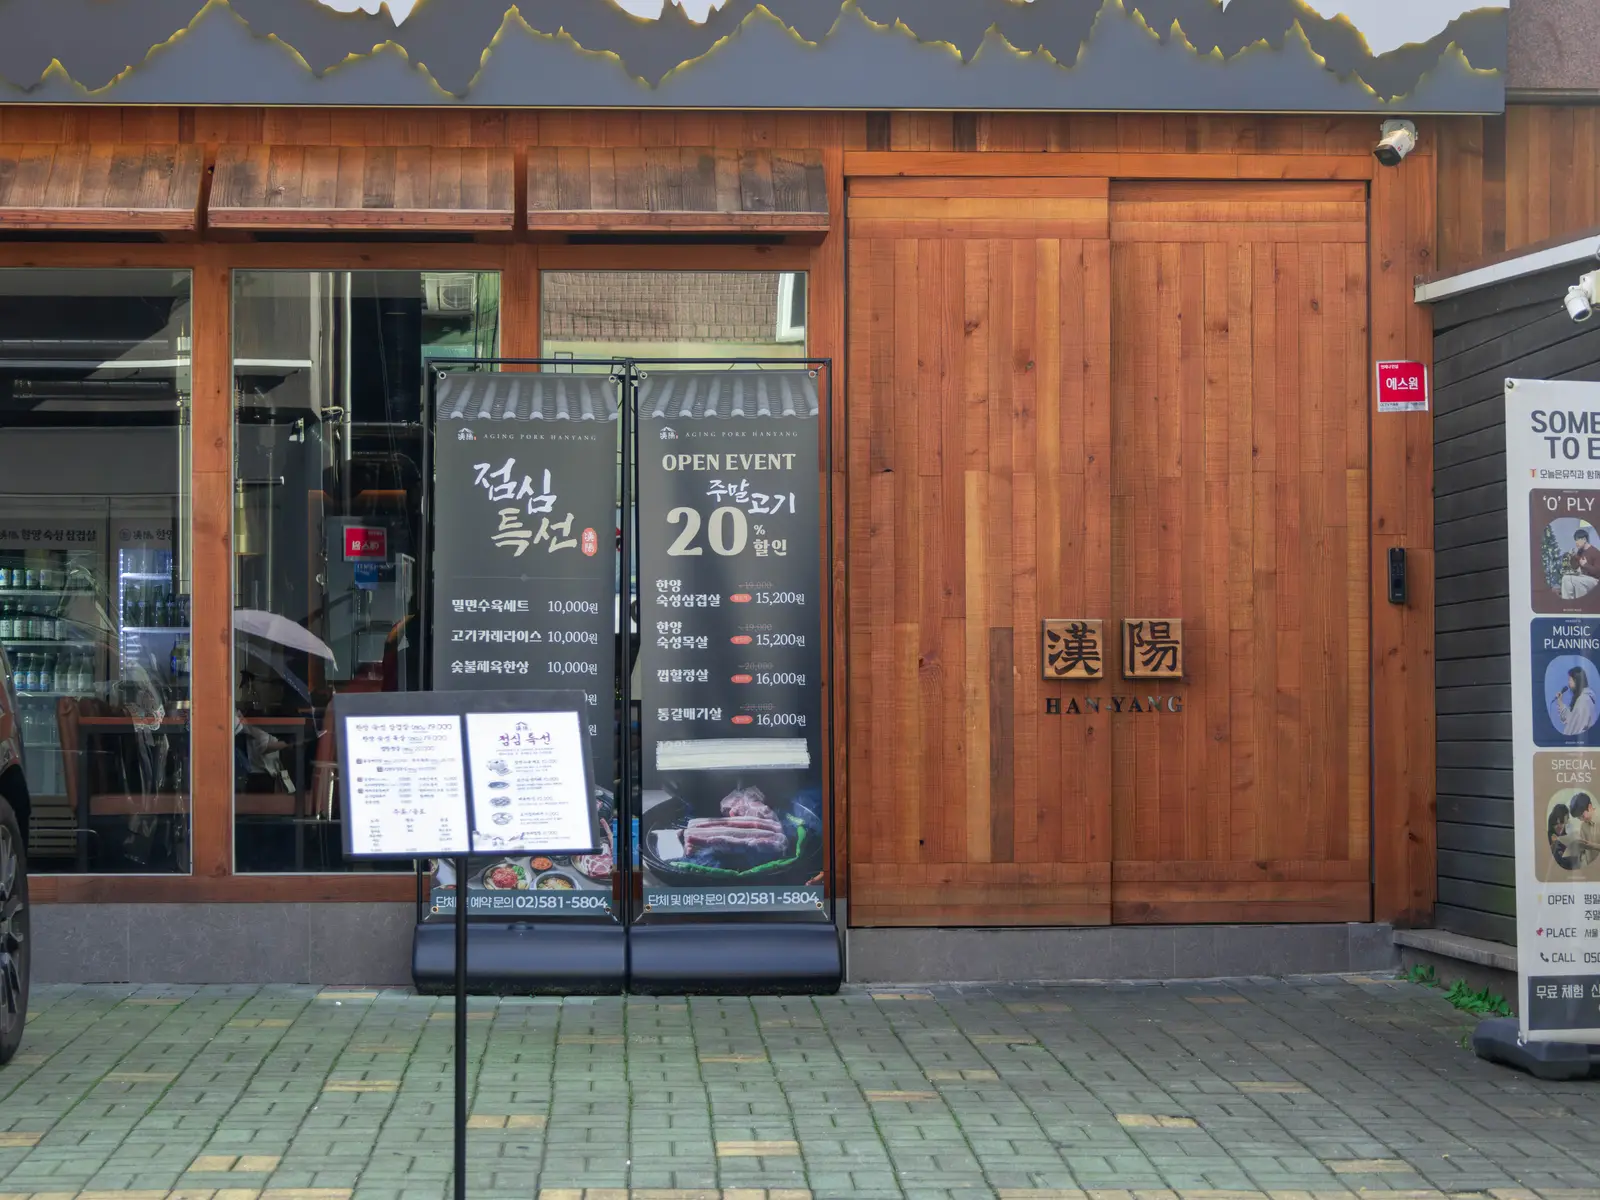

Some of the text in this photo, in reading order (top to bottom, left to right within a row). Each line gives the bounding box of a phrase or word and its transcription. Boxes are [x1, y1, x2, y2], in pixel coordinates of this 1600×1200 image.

[1386, 376, 1418, 390] 에스원
[1543, 436, 1580, 460] TO
[661, 453, 797, 471] OPEN EVENT
[473, 457, 557, 515] 점심
[1567, 497, 1595, 511] PLY
[490, 507, 578, 557] 특선
[752, 539, 787, 557] 할인
[655, 579, 682, 593] 한양
[451, 599, 530, 613] 밀면수육세트
[655, 594, 721, 608] 숙성삼겹살
[755, 592, 805, 606] 15,200원
[548, 600, 599, 615] 10,000원
[656, 621, 683, 635] 한양
[1552, 625, 1591, 636] MUISIC
[451, 630, 543, 643] 고기카레라이스
[548, 631, 598, 645] 10,000원
[656, 636, 709, 650] 숙성목살
[755, 634, 806, 648] 15,200원
[1544, 638, 1600, 649] PLANNING
[1047, 621, 1180, 675] 漢陽
[451, 660, 530, 675] 숯불제육한상
[547, 661, 598, 676] 10,000원
[756, 672, 806, 687] 16,000원
[657, 708, 723, 721] 통갈매기살
[756, 714, 807, 728] 16,000원
[498, 731, 552, 746] 점심 특선
[1551, 759, 1597, 770] SPECIAL
[1556, 772, 1592, 783] CLASS
[470, 896, 492, 909] 예약
[493, 896, 514, 908] 문의
[515, 896, 608, 909] 02)581-5804
[648, 891, 819, 907] 단체 및 예약 문의 02)581-5804
[1548, 895, 1575, 905] OPEN
[1546, 928, 1577, 938] PLACE
[1552, 953, 1576, 963] CALL
[1536, 985, 1558, 999] 무료
[1561, 984, 1584, 999] 체험
